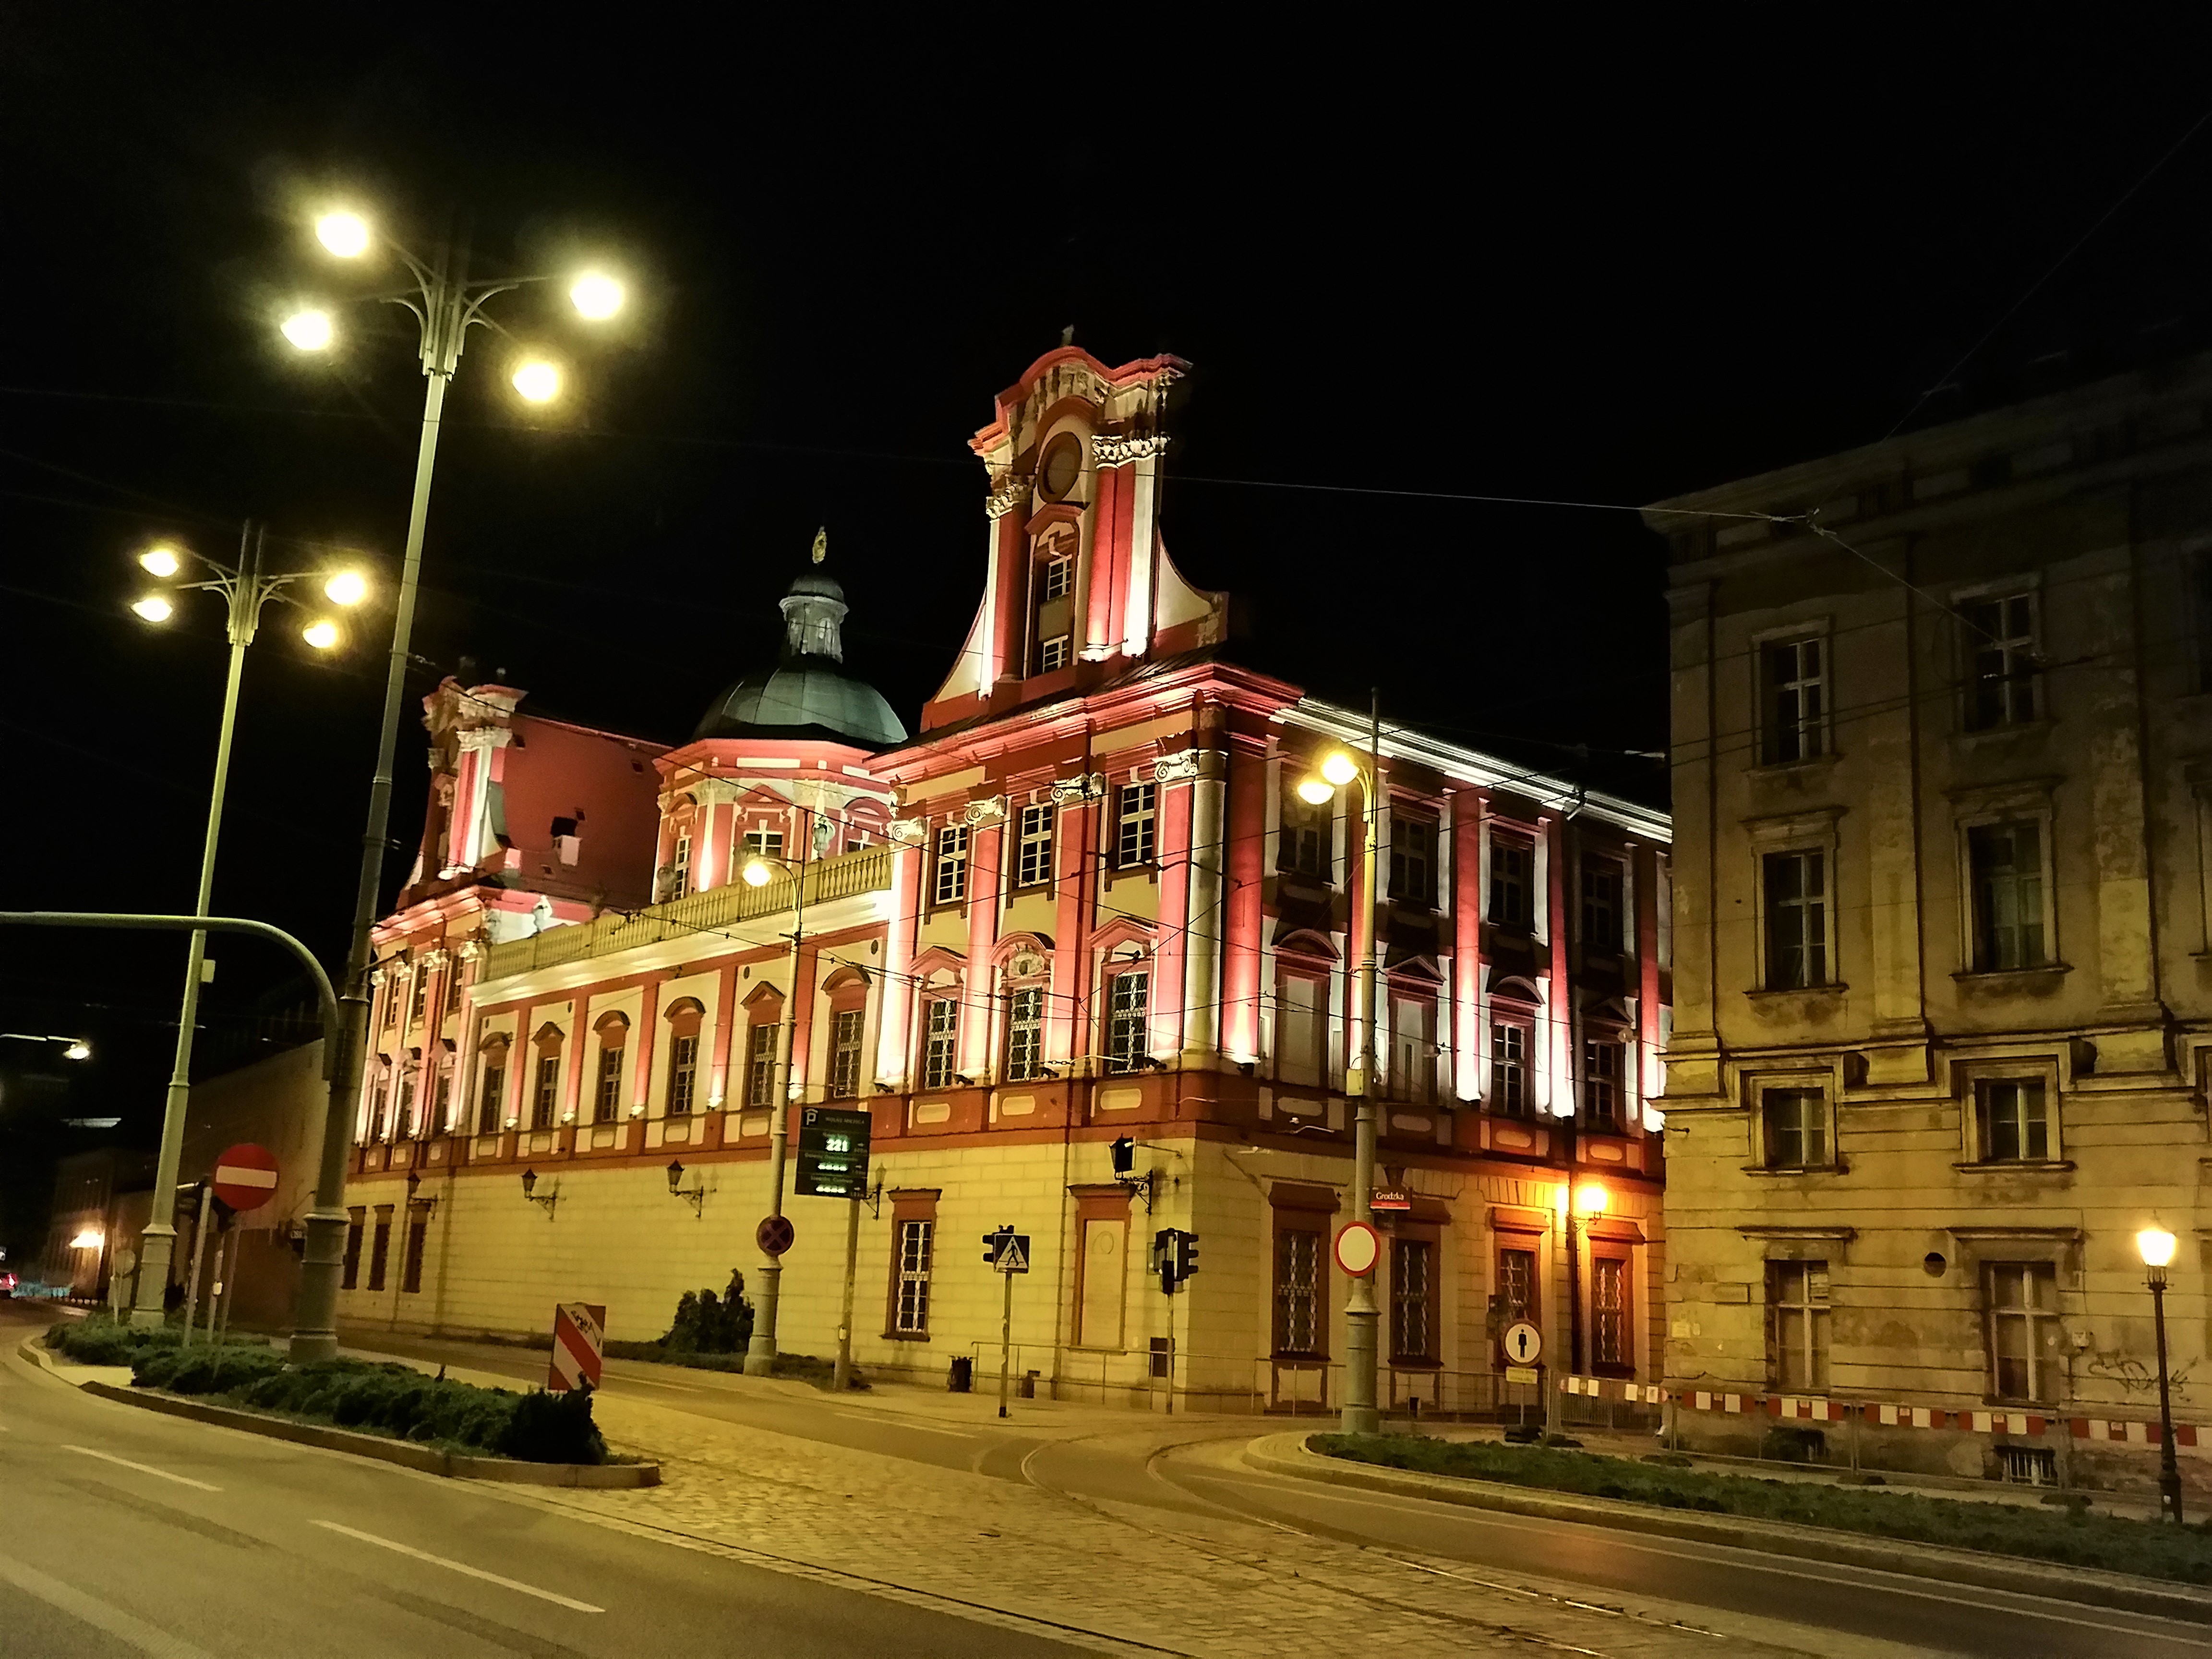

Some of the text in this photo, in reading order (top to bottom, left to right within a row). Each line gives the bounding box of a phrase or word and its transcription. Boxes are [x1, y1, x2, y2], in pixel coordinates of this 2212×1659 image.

[806, 1112, 817, 1125] P
[826, 1139, 848, 1152] 221
[1376, 1191, 1405, 1201] Grodzka
